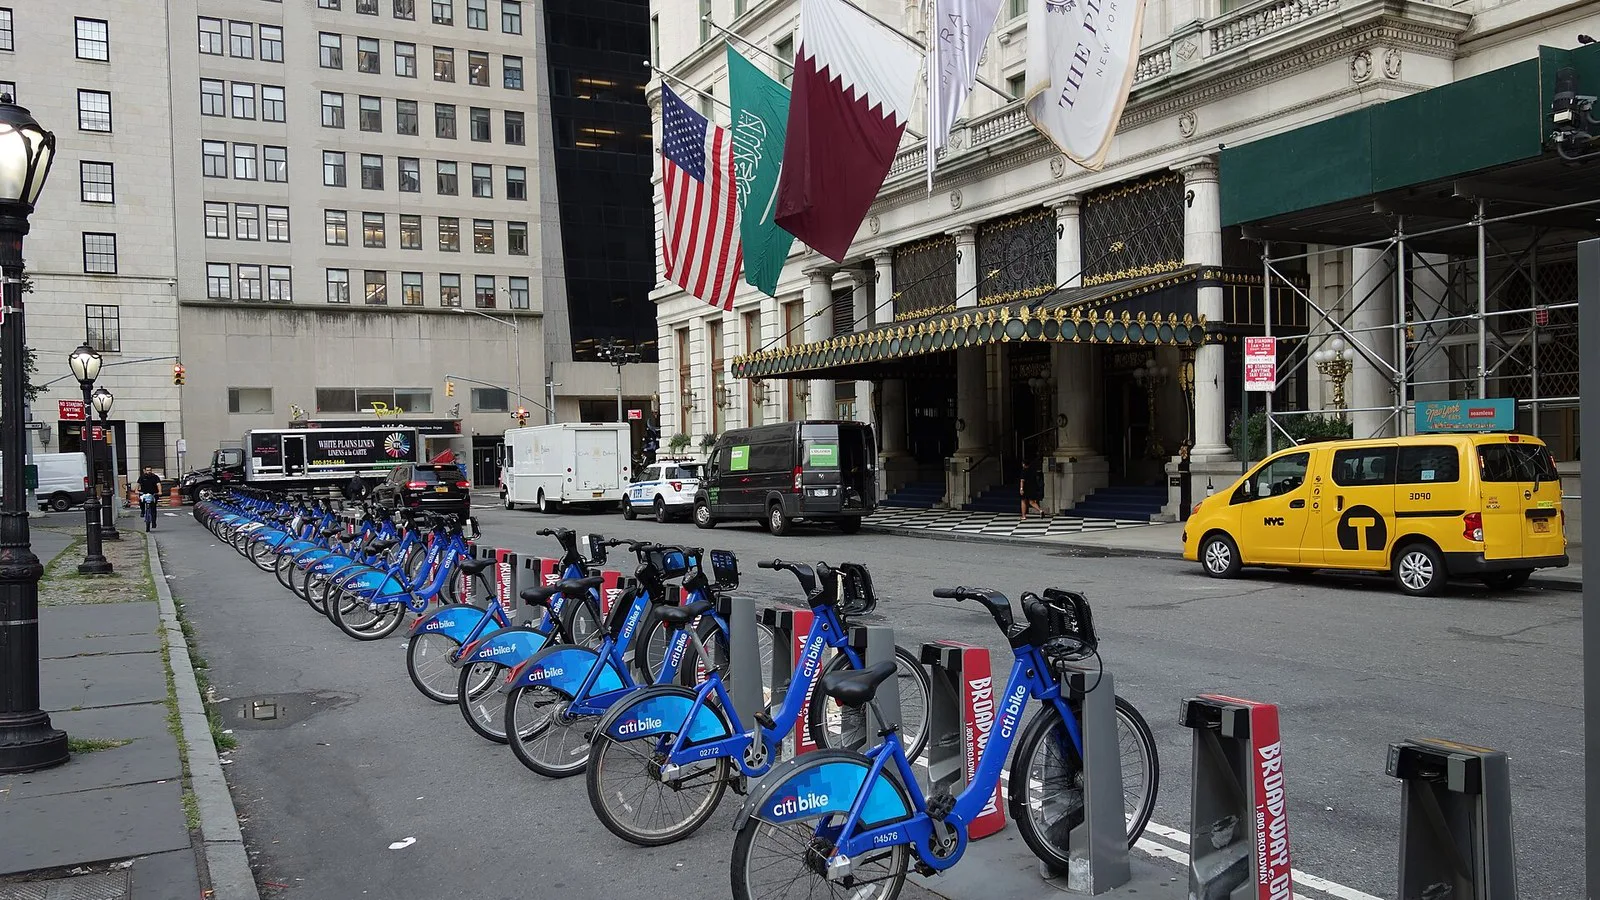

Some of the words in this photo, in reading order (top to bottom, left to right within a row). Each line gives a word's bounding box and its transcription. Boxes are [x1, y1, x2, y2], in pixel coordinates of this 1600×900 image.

[1096, 43, 1110, 77] NEW
[1058, 42, 1091, 111] THE
[370, 401, 404, 419] Paris
[318, 440, 337, 448] WHITE
[338, 440, 357, 448] PLAINS
[358, 440, 375, 448] LINEN
[634, 489, 642, 498] NYPD
[1264, 517, 1284, 526] NYC
[426, 622, 438, 630] citi
[624, 625, 632, 638] citi
[628, 612, 640, 627] bike
[479, 648, 493, 658] citi
[493, 646, 510, 655] bike
[675, 633, 688, 654] bike
[808, 636, 823, 660] bike
[671, 651, 681, 667] citi
[803, 658, 815, 678] citi
[528, 669, 543, 682] citi
[544, 667, 564, 679] bike
[1006, 685, 1026, 715] bike
[619, 719, 637, 734] citi
[638, 718, 662, 732] bike
[1000, 714, 1015, 738] citi
[700, 747, 719, 757] 02772
[774, 796, 797, 816] citi
[798, 794, 829, 811] bike
[1256, 804, 1268, 885] 1.800.BROADWAY
